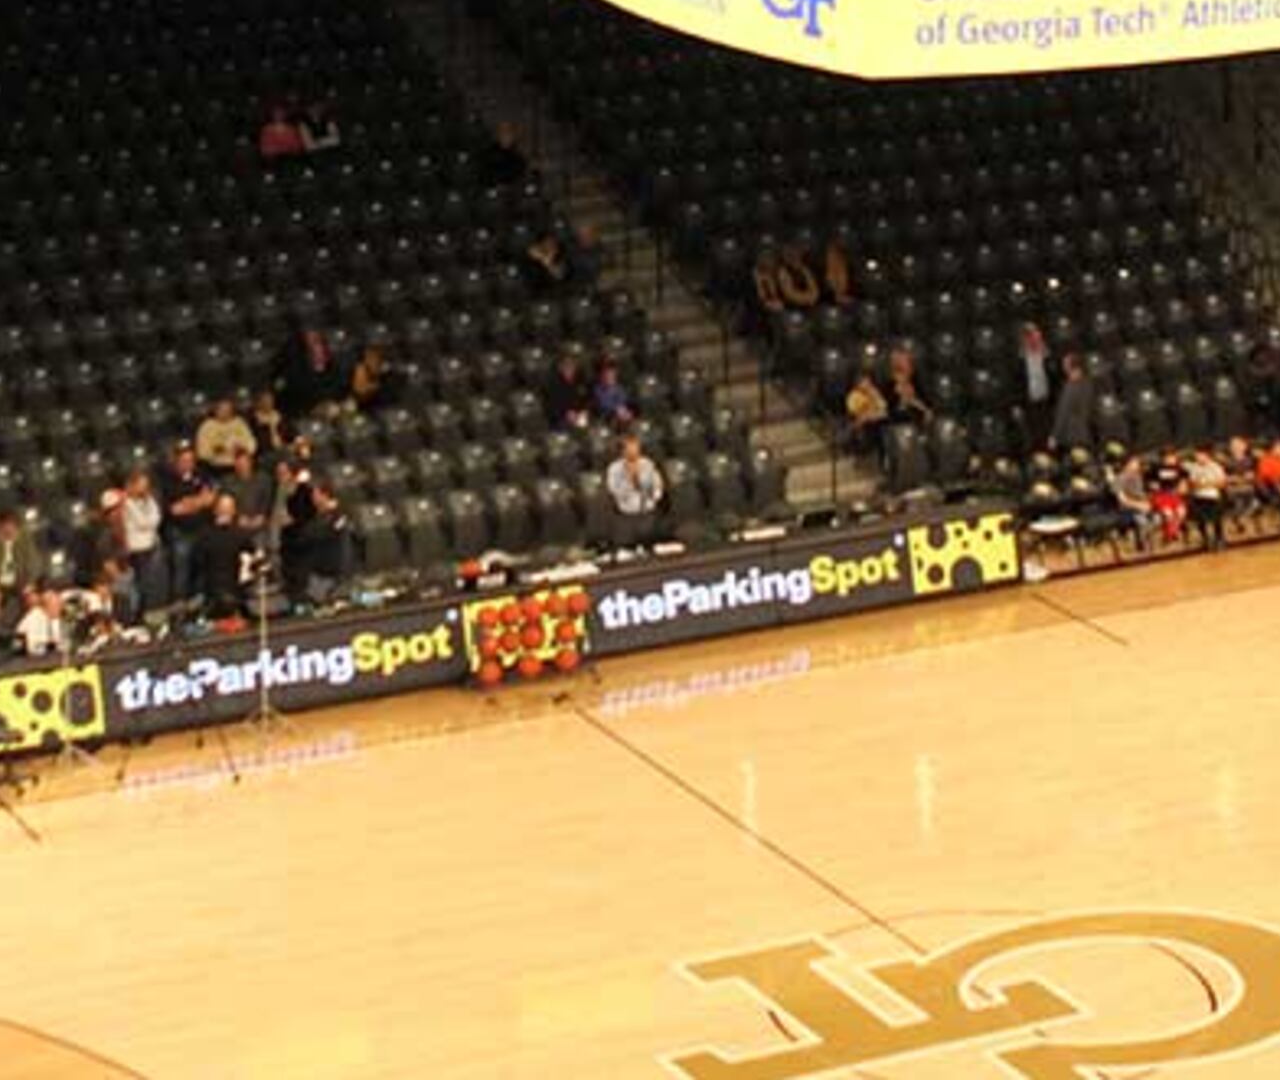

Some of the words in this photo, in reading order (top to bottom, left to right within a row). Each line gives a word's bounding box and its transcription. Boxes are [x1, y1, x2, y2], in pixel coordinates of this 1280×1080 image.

[916, 17, 947, 48] of
[956, 10, 1082, 49] Georgia
[597, 549, 901, 629] theParkingSpot
[115, 627, 455, 712] theParkingSpot
